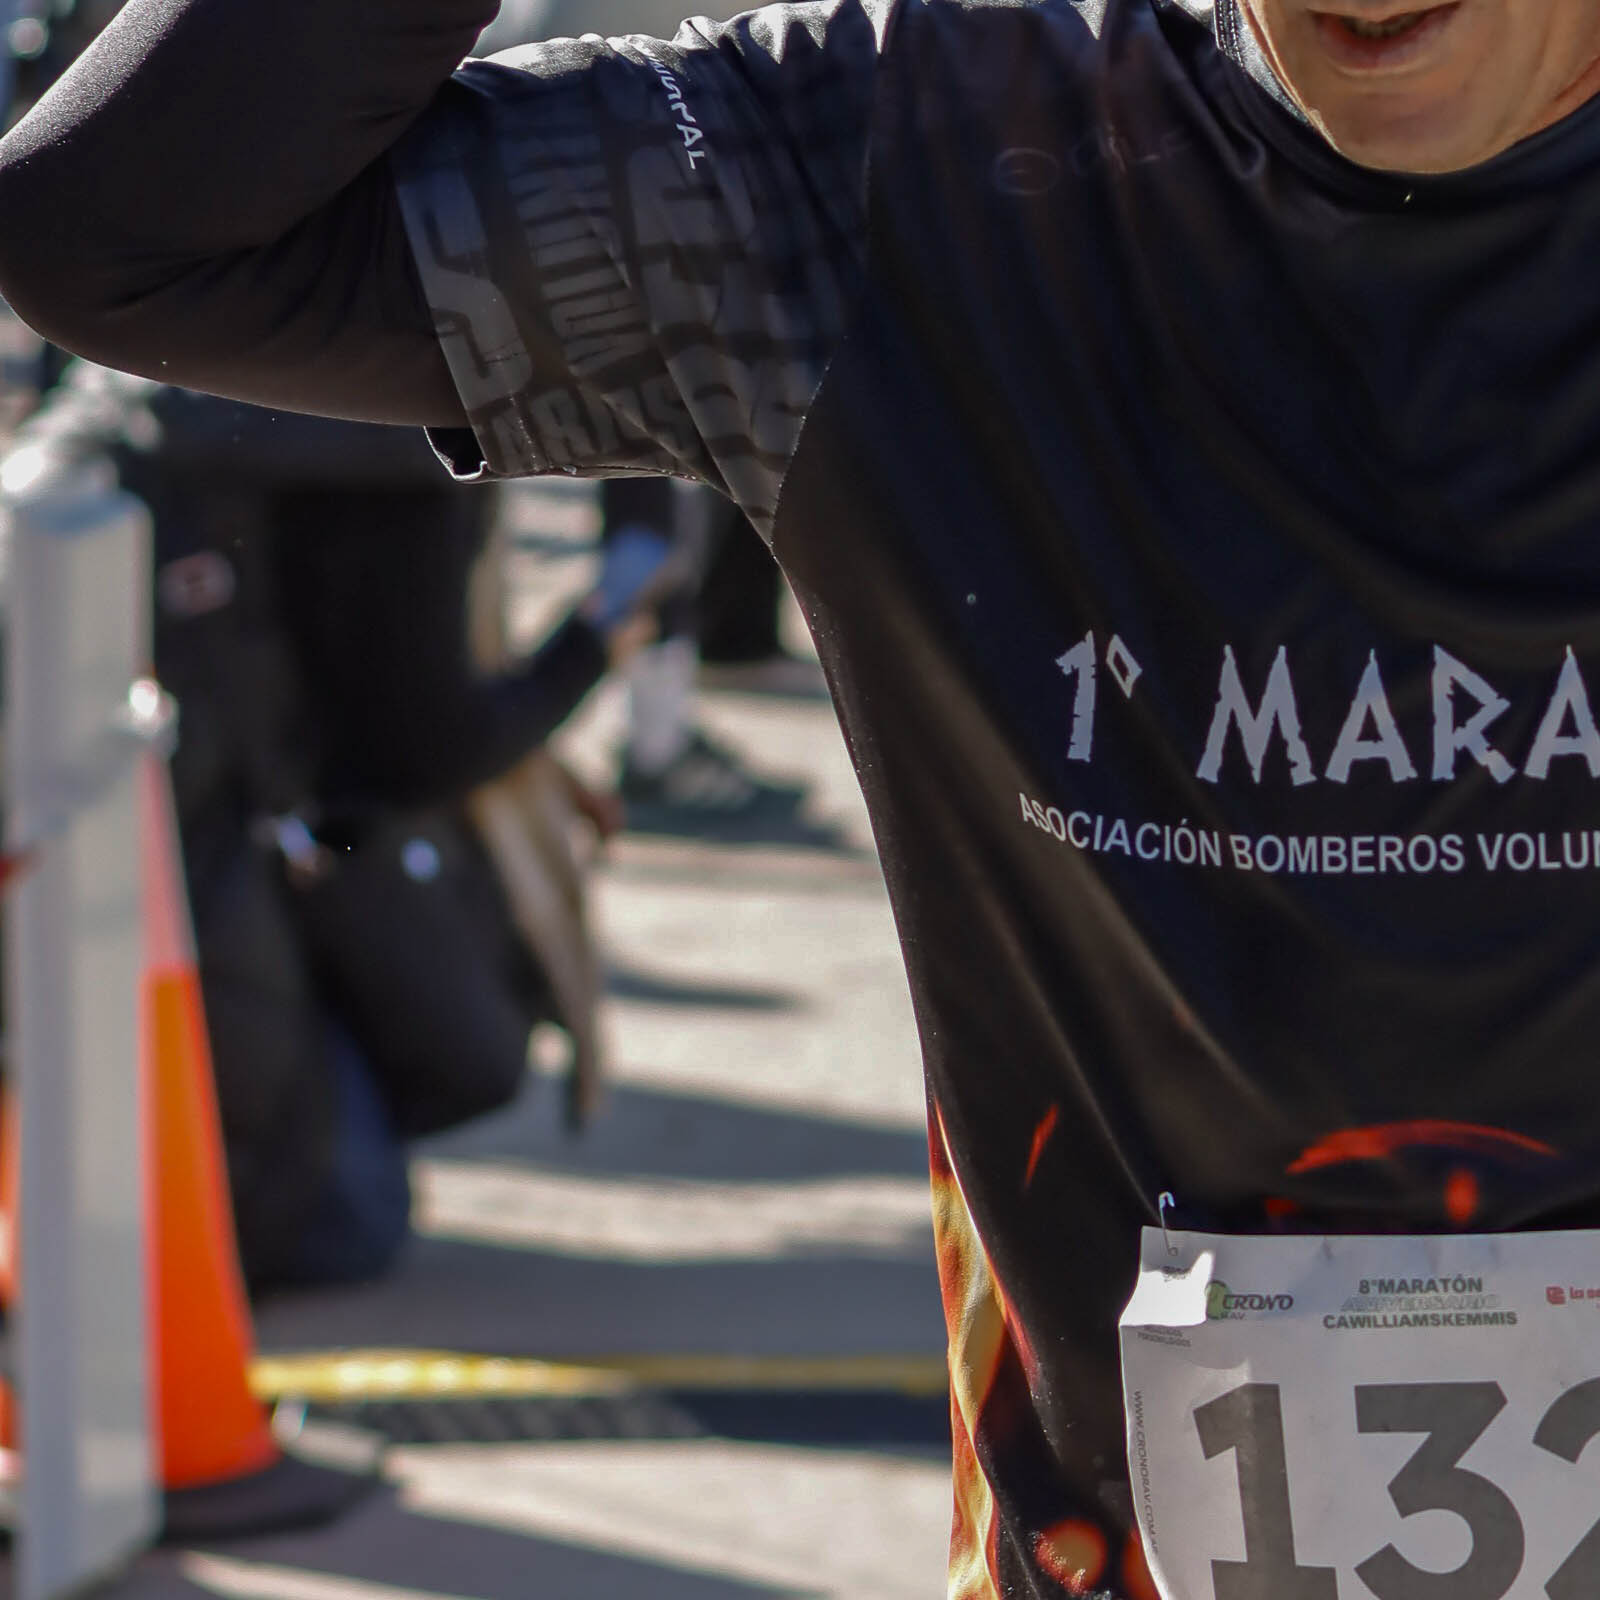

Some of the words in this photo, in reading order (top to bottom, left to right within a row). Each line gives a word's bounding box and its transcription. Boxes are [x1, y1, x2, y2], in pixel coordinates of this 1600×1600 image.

[1018, 793, 1223, 866] ASOCIACIÓN
[1229, 834, 1465, 874] BOMBEROS
[1569, 1286, 1585, 1300] la
[1323, 1310, 1518, 1329] CAWILLIAMSKEMMIS
